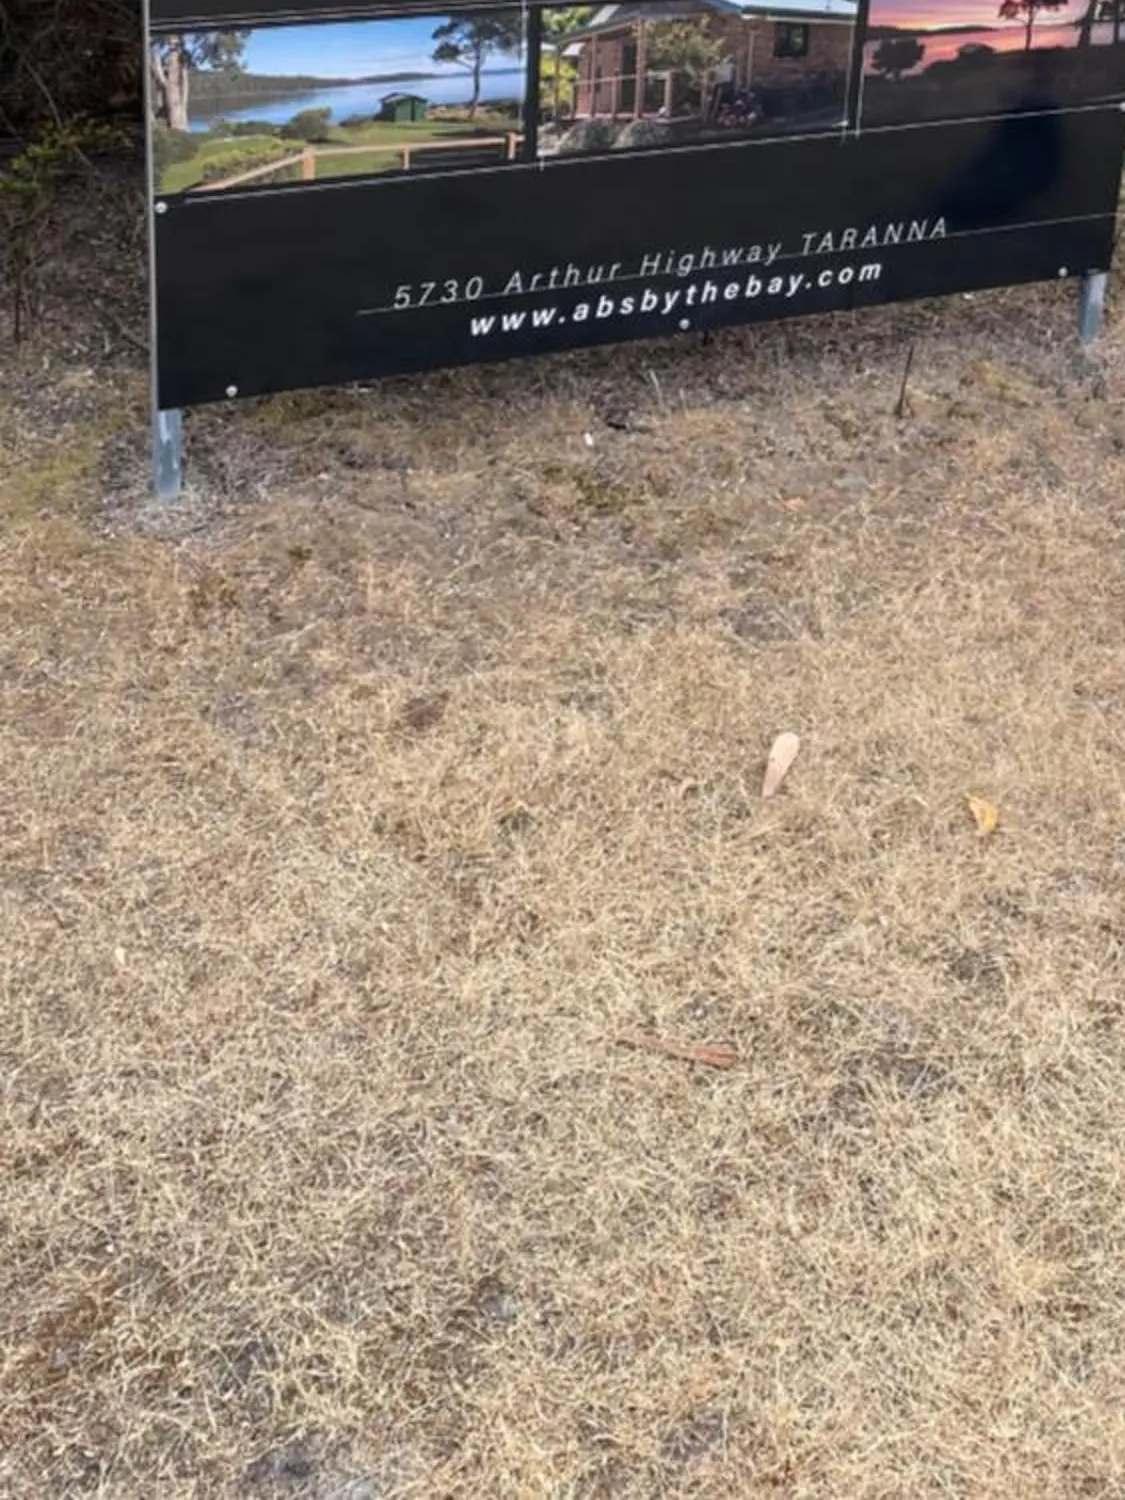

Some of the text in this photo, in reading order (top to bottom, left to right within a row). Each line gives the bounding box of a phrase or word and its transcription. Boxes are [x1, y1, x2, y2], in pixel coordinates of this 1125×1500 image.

[392, 216, 949, 310] 5730 Arthur Highway TARANNA
[469, 260, 882, 337] www.absbythebay.com
